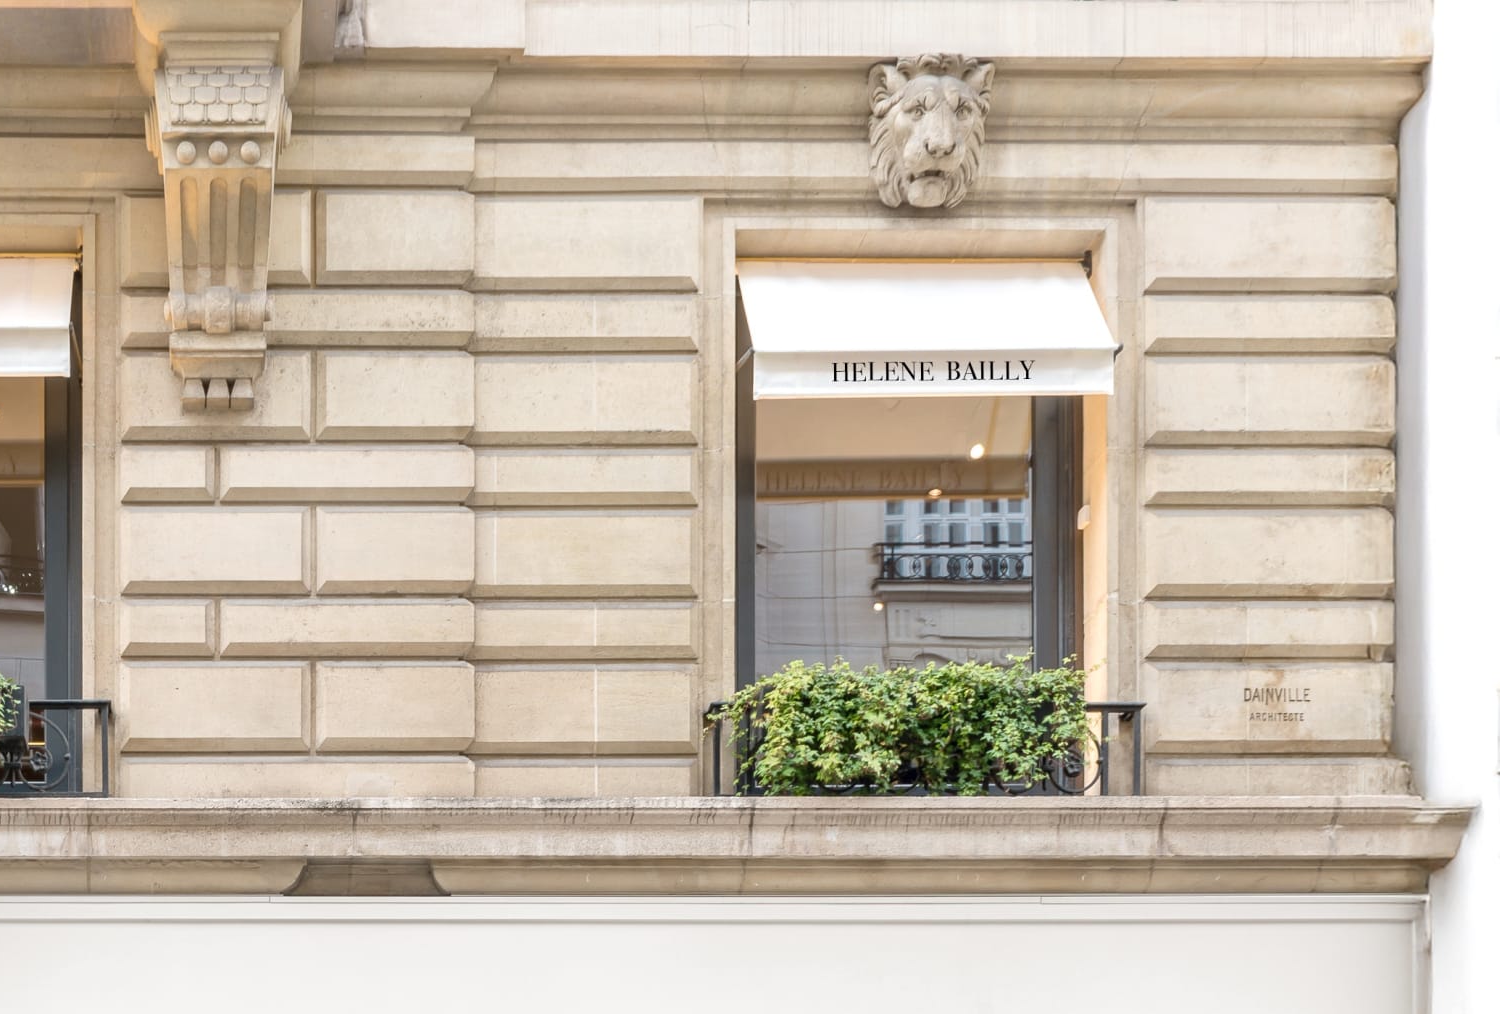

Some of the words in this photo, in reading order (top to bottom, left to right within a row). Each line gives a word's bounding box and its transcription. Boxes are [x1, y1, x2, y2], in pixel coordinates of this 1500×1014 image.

[832, 361, 934, 382] HELENE
[947, 360, 1036, 381] BAILLY
[1243, 687, 1311, 703] DAINVILLE
[1249, 712, 1304, 722] ARCHITECTE
